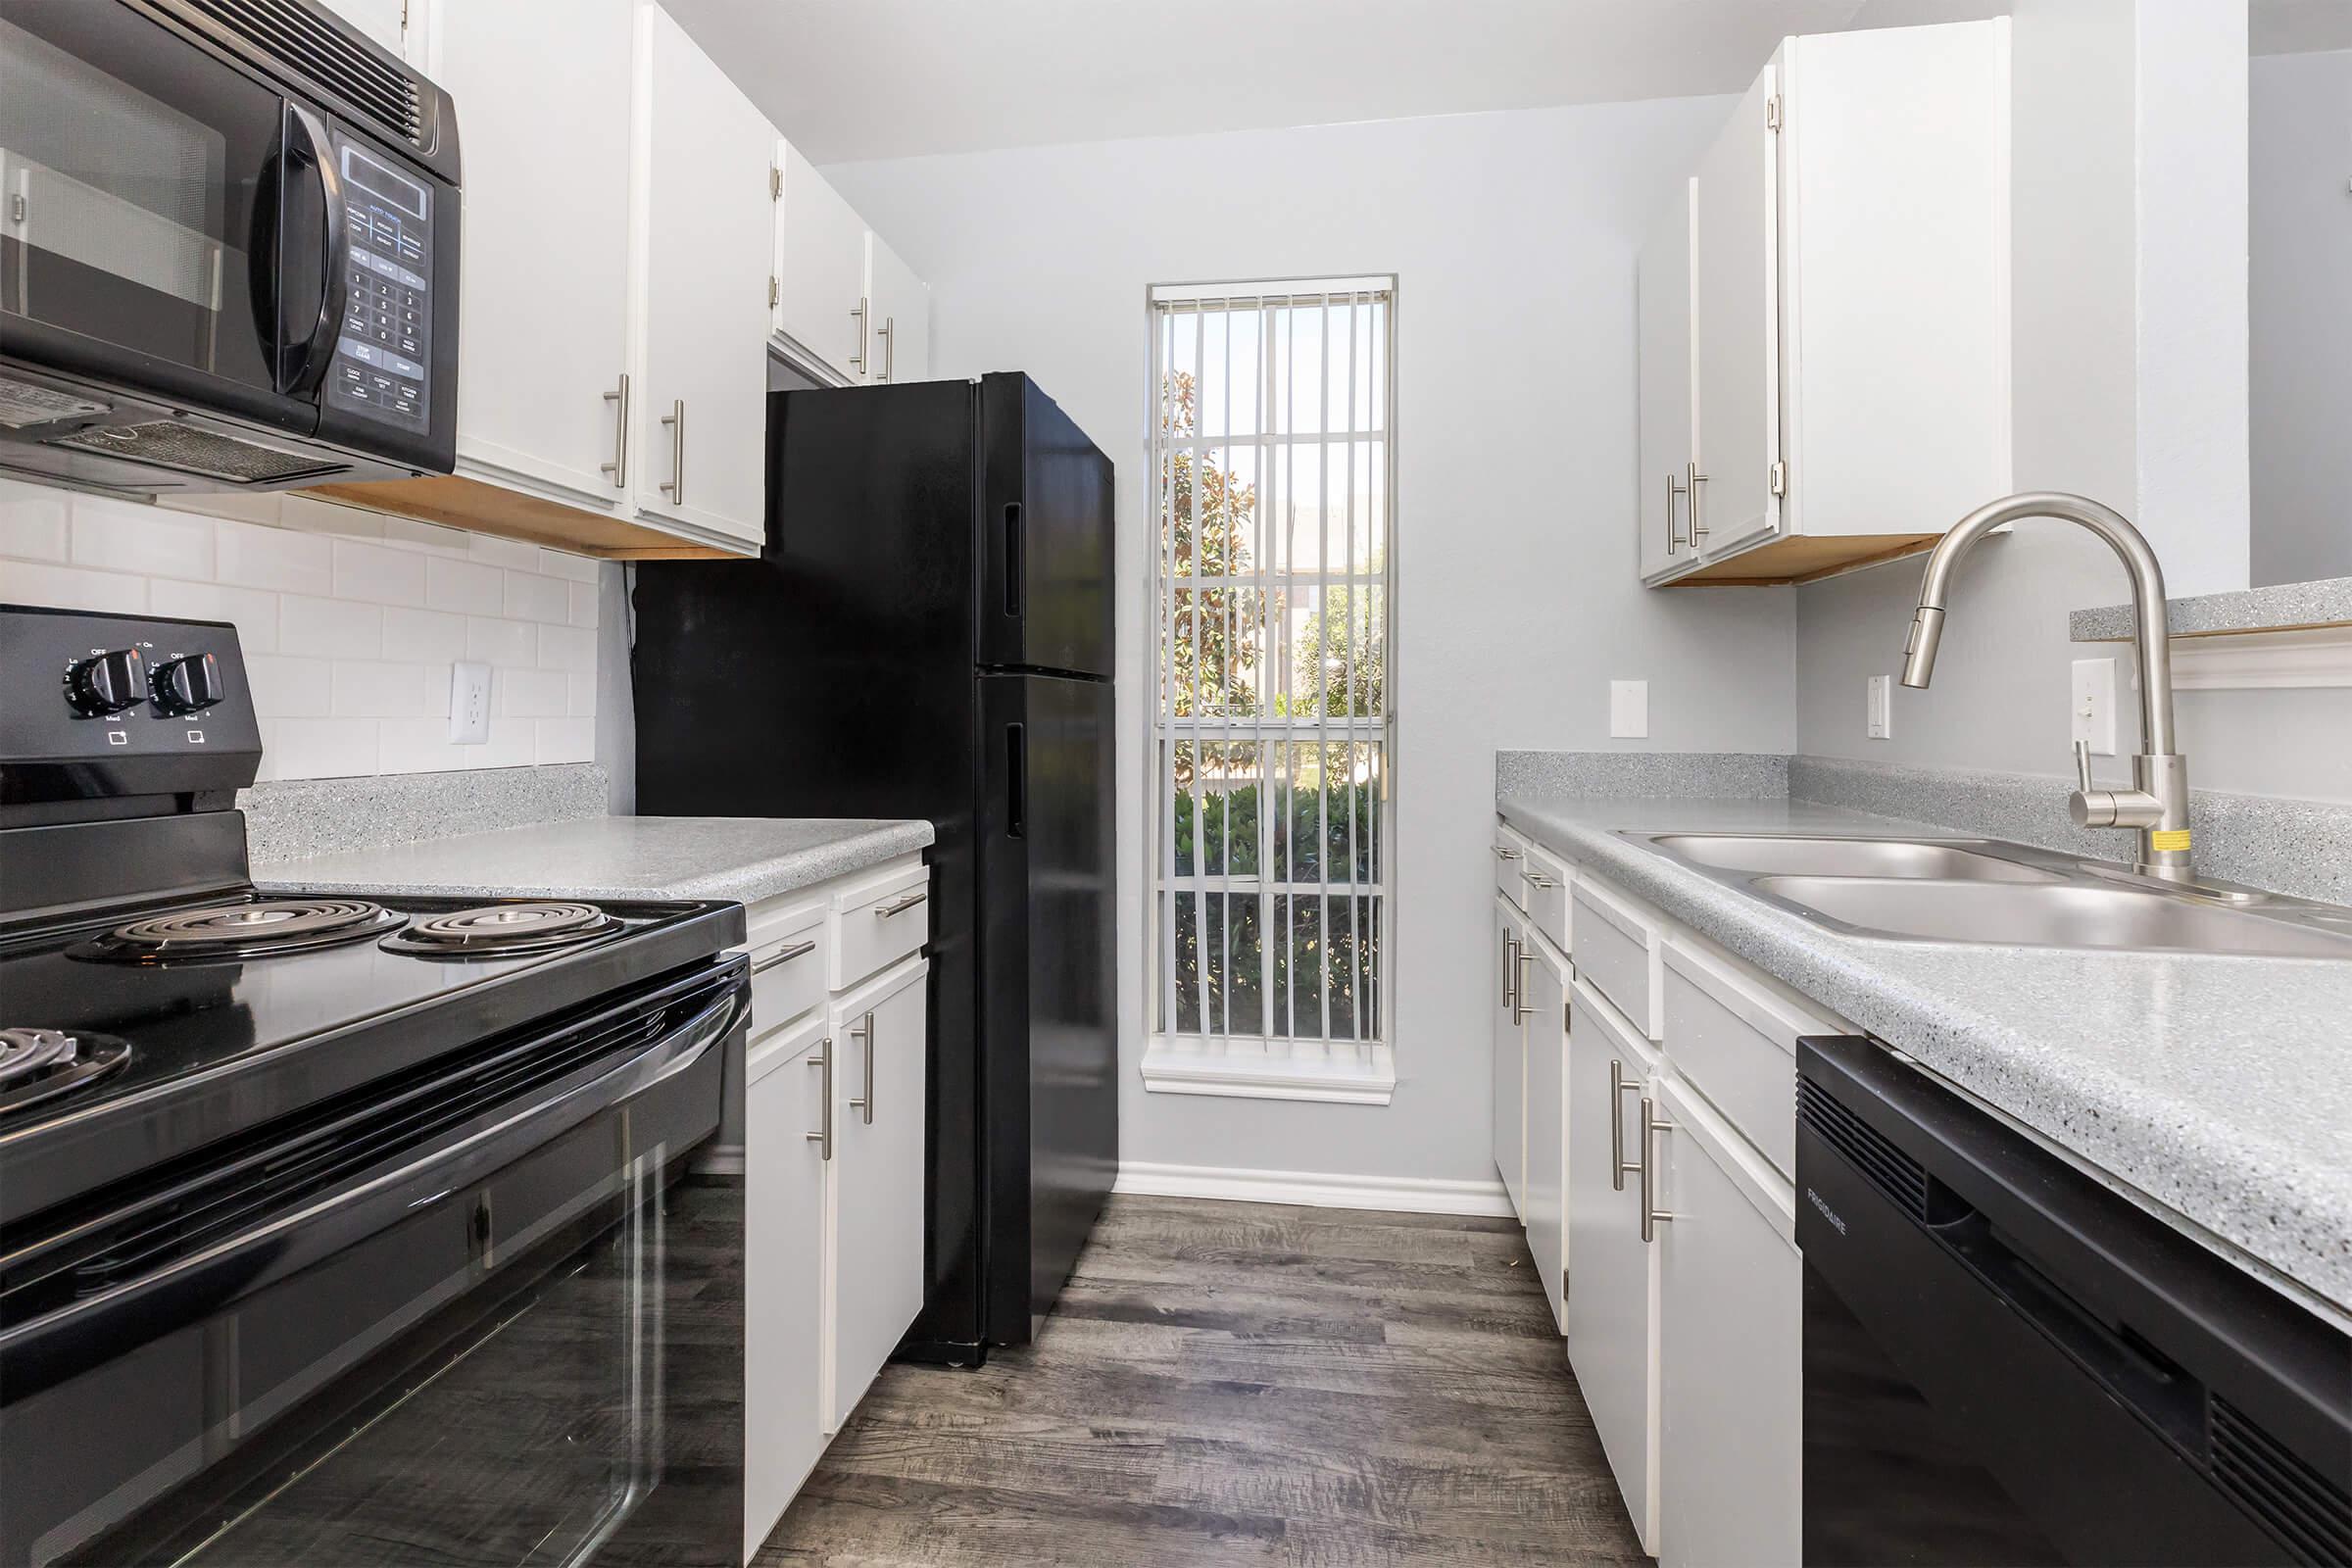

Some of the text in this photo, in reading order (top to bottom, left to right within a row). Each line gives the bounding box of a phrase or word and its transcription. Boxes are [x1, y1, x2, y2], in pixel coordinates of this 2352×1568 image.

[370, 204, 384, 215] AUTO
[382, 285, 387, 295] 2
[354, 305, 360, 314] 7
[381, 301, 387, 310] 5
[381, 316, 387, 324] 8
[407, 312, 413, 320] 6
[349, 318, 365, 327] POWER
[407, 326, 412, 335] 9
[357, 344, 369, 353] STOP
[356, 351, 370, 361] CLEAR
[396, 362, 411, 371] START
[347, 368, 362, 377] CLOCK
[1806, 1187, 1846, 1237] FRIGIDAIRE
